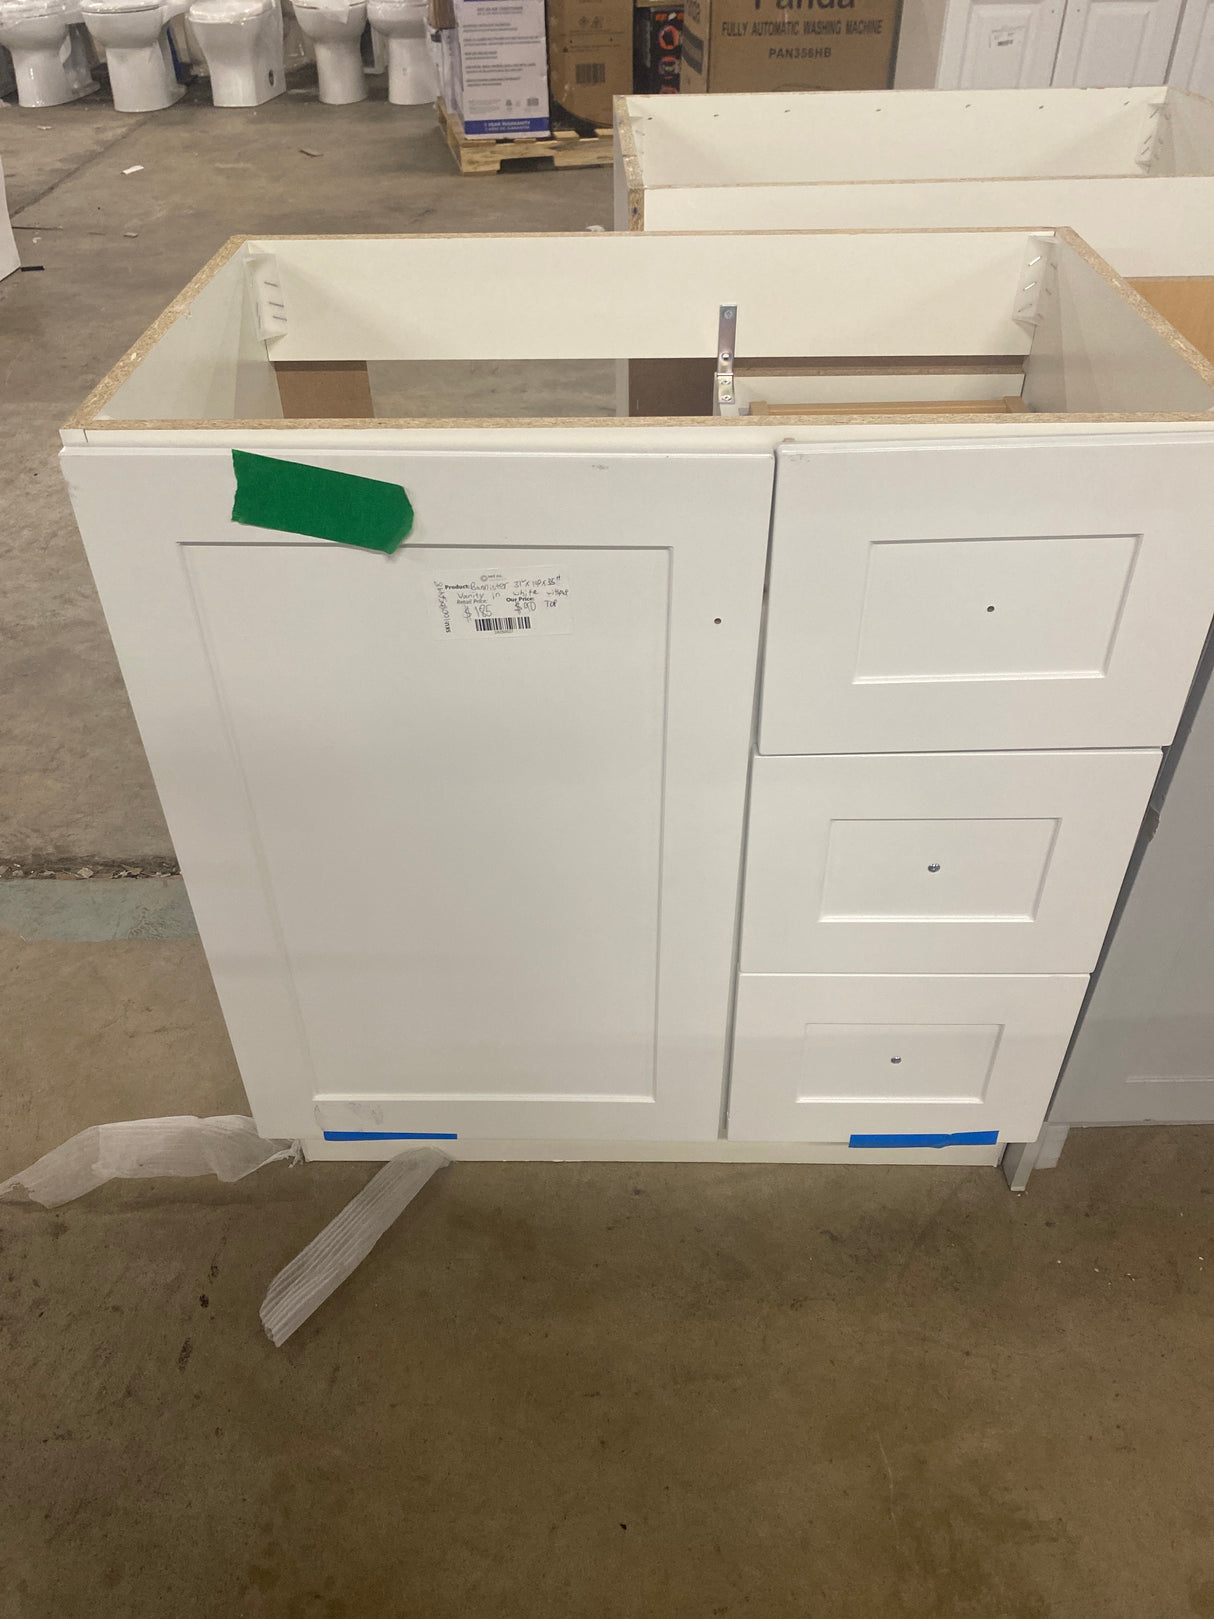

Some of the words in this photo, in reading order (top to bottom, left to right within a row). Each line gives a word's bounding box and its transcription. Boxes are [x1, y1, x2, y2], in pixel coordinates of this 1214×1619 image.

[722, 22, 747, 37] FULLY
[751, 21, 799, 36] AUTOMATIC
[803, 20, 842, 36] WASHING
[846, 19, 883, 35] MACHINE
[457, 592, 485, 600] Vanity
